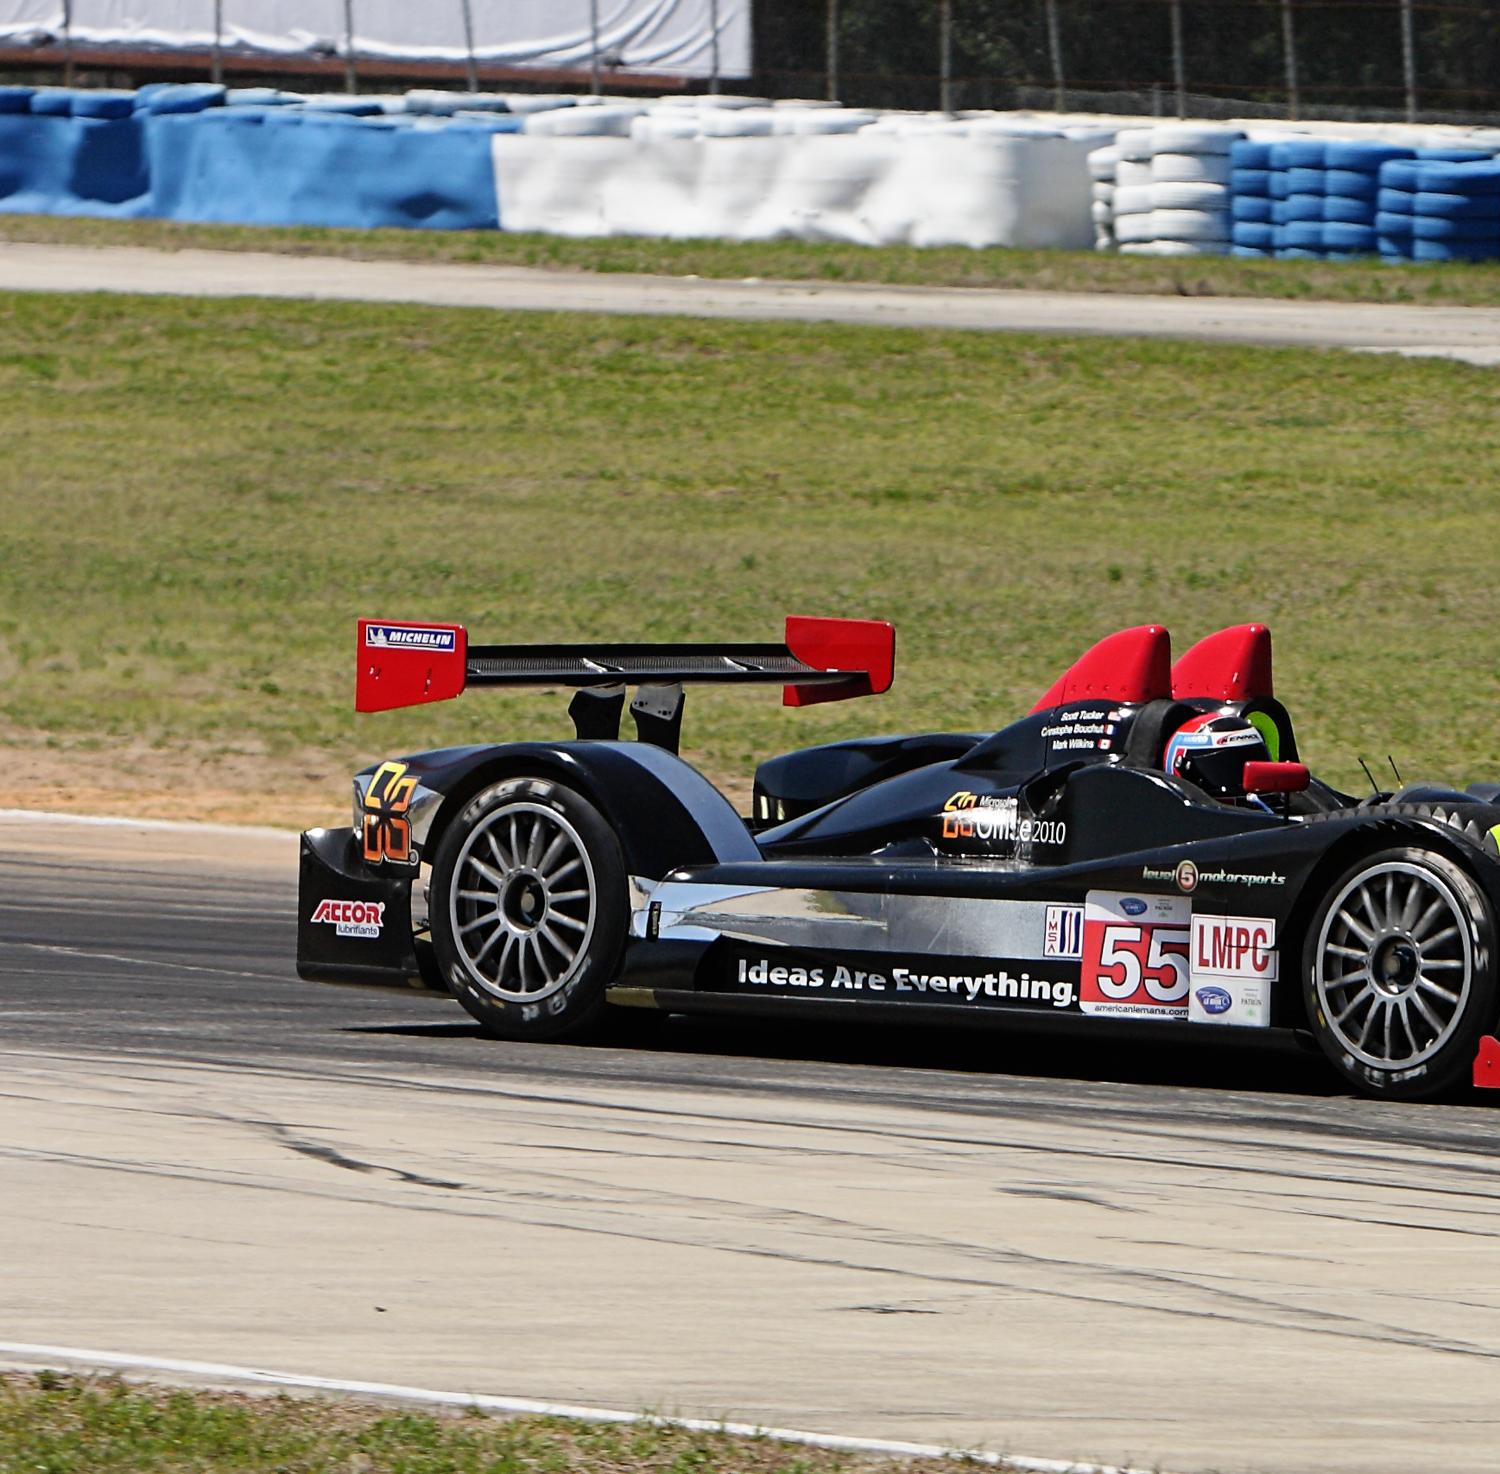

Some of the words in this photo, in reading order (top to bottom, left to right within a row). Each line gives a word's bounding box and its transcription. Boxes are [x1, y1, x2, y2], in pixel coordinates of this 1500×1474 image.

[389, 631, 452, 645] MICHELIN
[1061, 711, 1079, 721] Scott
[1079, 710, 1105, 720] Tucker
[1052, 740, 1068, 750] Mark
[1068, 738, 1094, 750] Wilkins
[1031, 820, 1066, 845] 2010
[1199, 868, 1286, 887] motorsports
[314, 902, 381, 925] ACCOR
[1198, 924, 1270, 972] LMPC
[1096, 925, 1190, 1002] 55
[738, 959, 825, 988] Ideas
[830, 965, 886, 991] Are
[892, 968, 1078, 1007] Everything.
[1095, 1004, 1189, 1016] americanlemans.com
